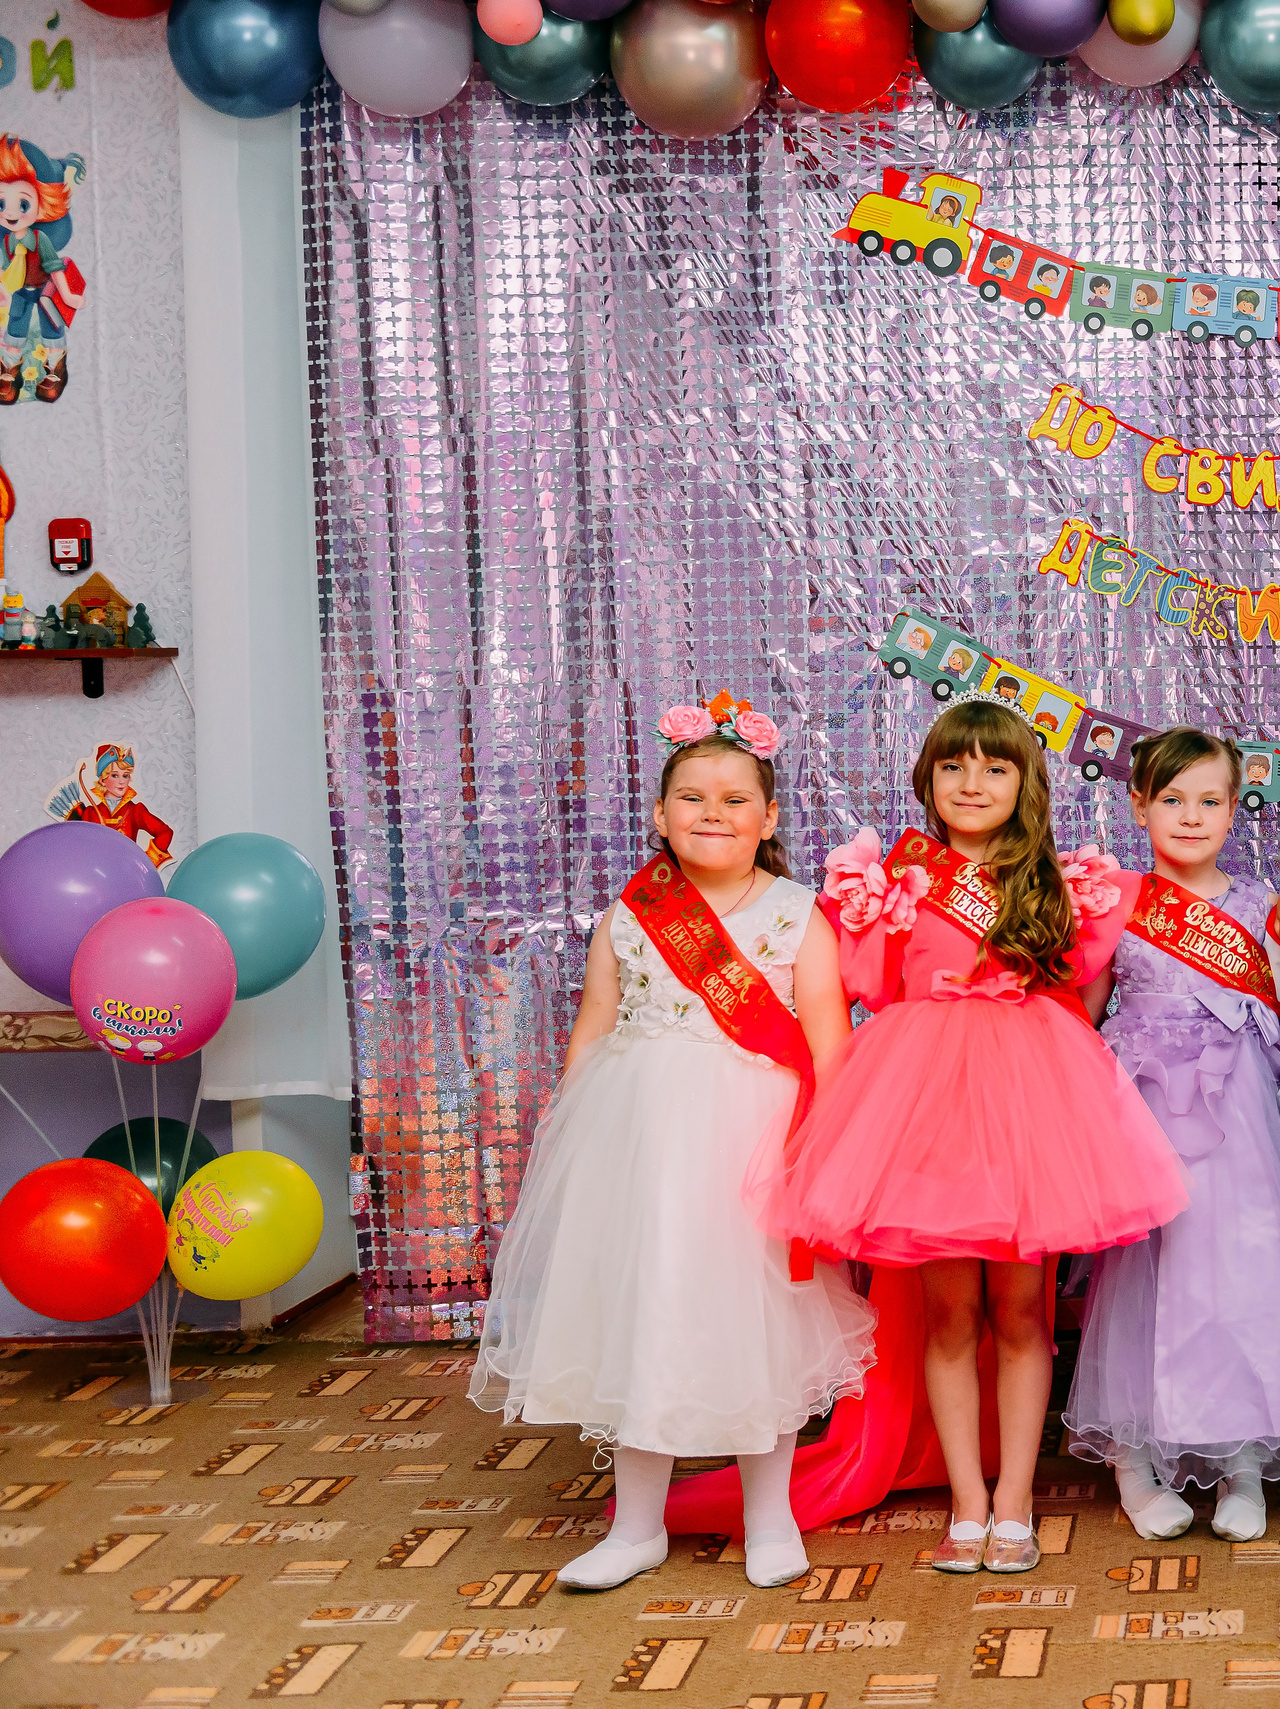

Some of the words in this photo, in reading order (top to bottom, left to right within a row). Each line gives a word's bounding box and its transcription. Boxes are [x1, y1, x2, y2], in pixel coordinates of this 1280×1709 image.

[1028, 383, 1117, 460] ДО
[1178, 926, 1249, 979] ДЕТСКОГО
[103, 998, 174, 1026] СКОРО
